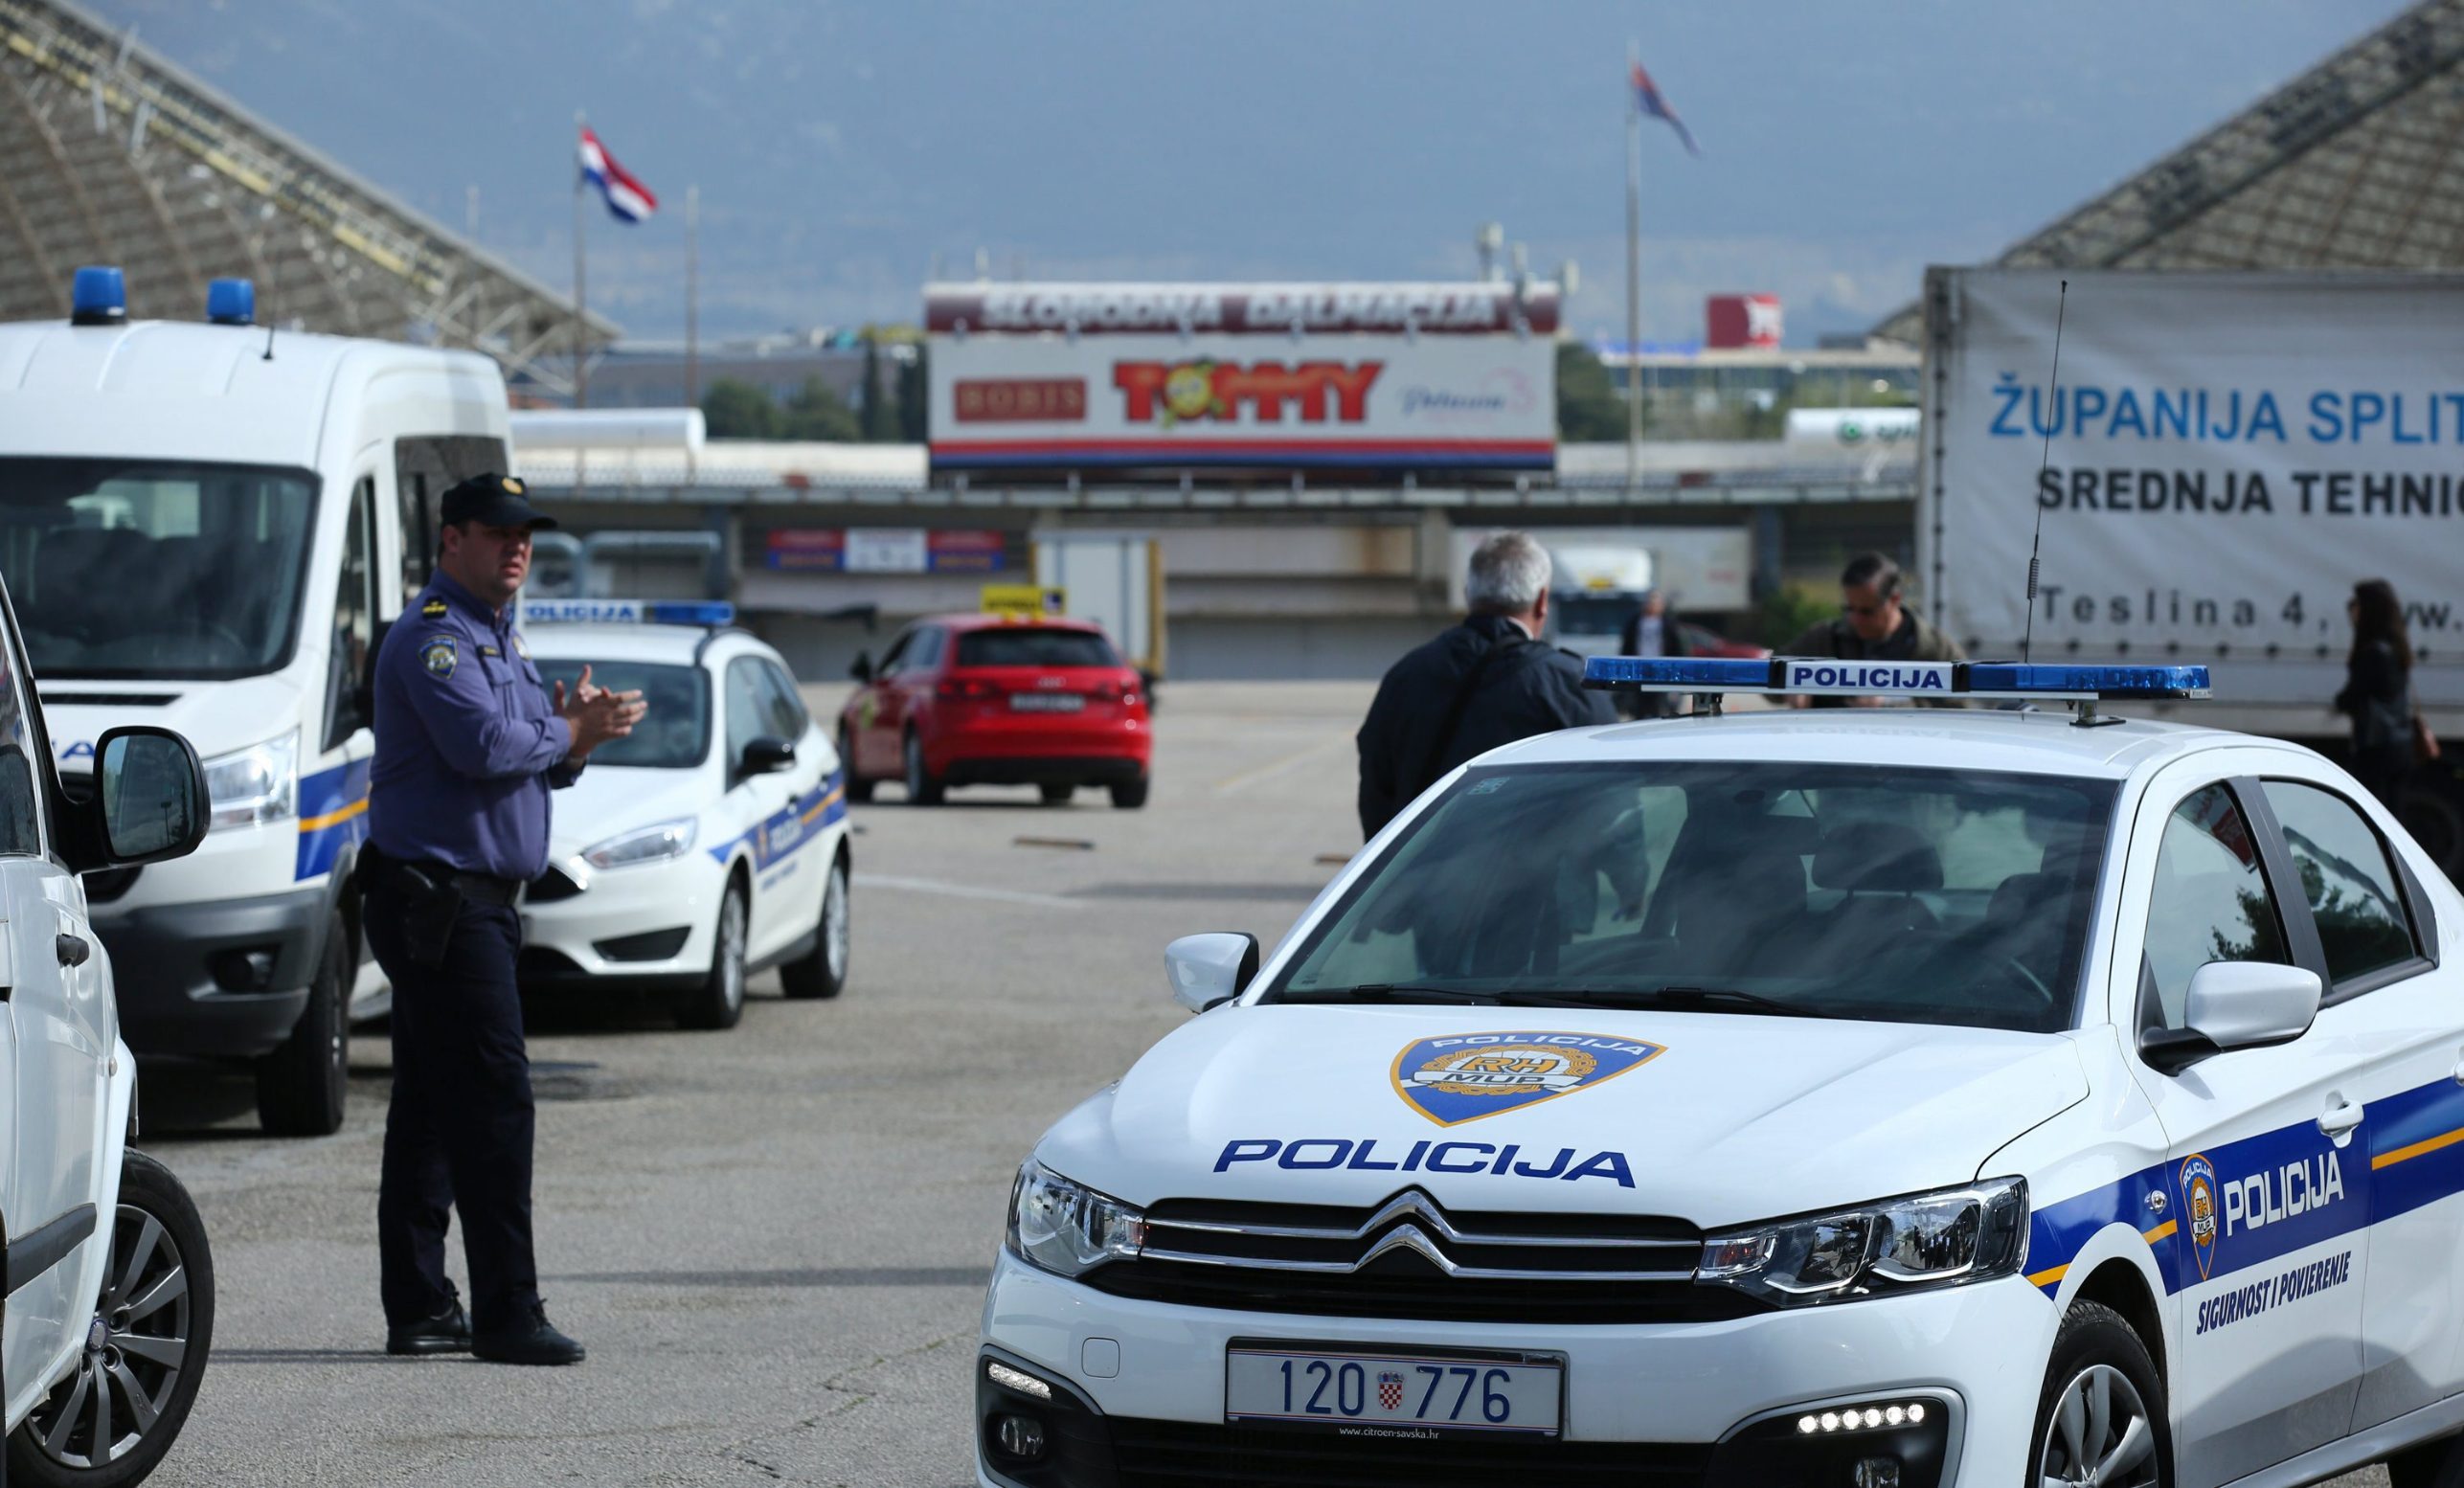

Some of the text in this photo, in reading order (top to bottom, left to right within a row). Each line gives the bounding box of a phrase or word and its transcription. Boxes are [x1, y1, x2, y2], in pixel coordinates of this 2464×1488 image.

[1114, 361, 1385, 423] TOMMY
[1989, 372, 2287, 441] ŽUPANIJA
[2037, 467, 2464, 516] SREDNJA TEHNI
[2039, 585, 2257, 628] Teslina
[1793, 665, 1943, 688] POLICIJA
[1433, 1034, 1647, 1057] POLICIJA
[1442, 1072, 1545, 1085] MUP
[1213, 1139, 1637, 1188] POLICIJA
[2183, 1161, 2213, 1188] POLICIJA
[2224, 1150, 2344, 1237] POLICIJA
[2197, 1220, 2211, 1233] MUP
[2196, 1251, 2352, 1336] SIGURNOST I POVJERENJE
[1280, 1360, 1511, 1424] 120 776
[1339, 1426, 1440, 1440] www.citroen-savska.hr
